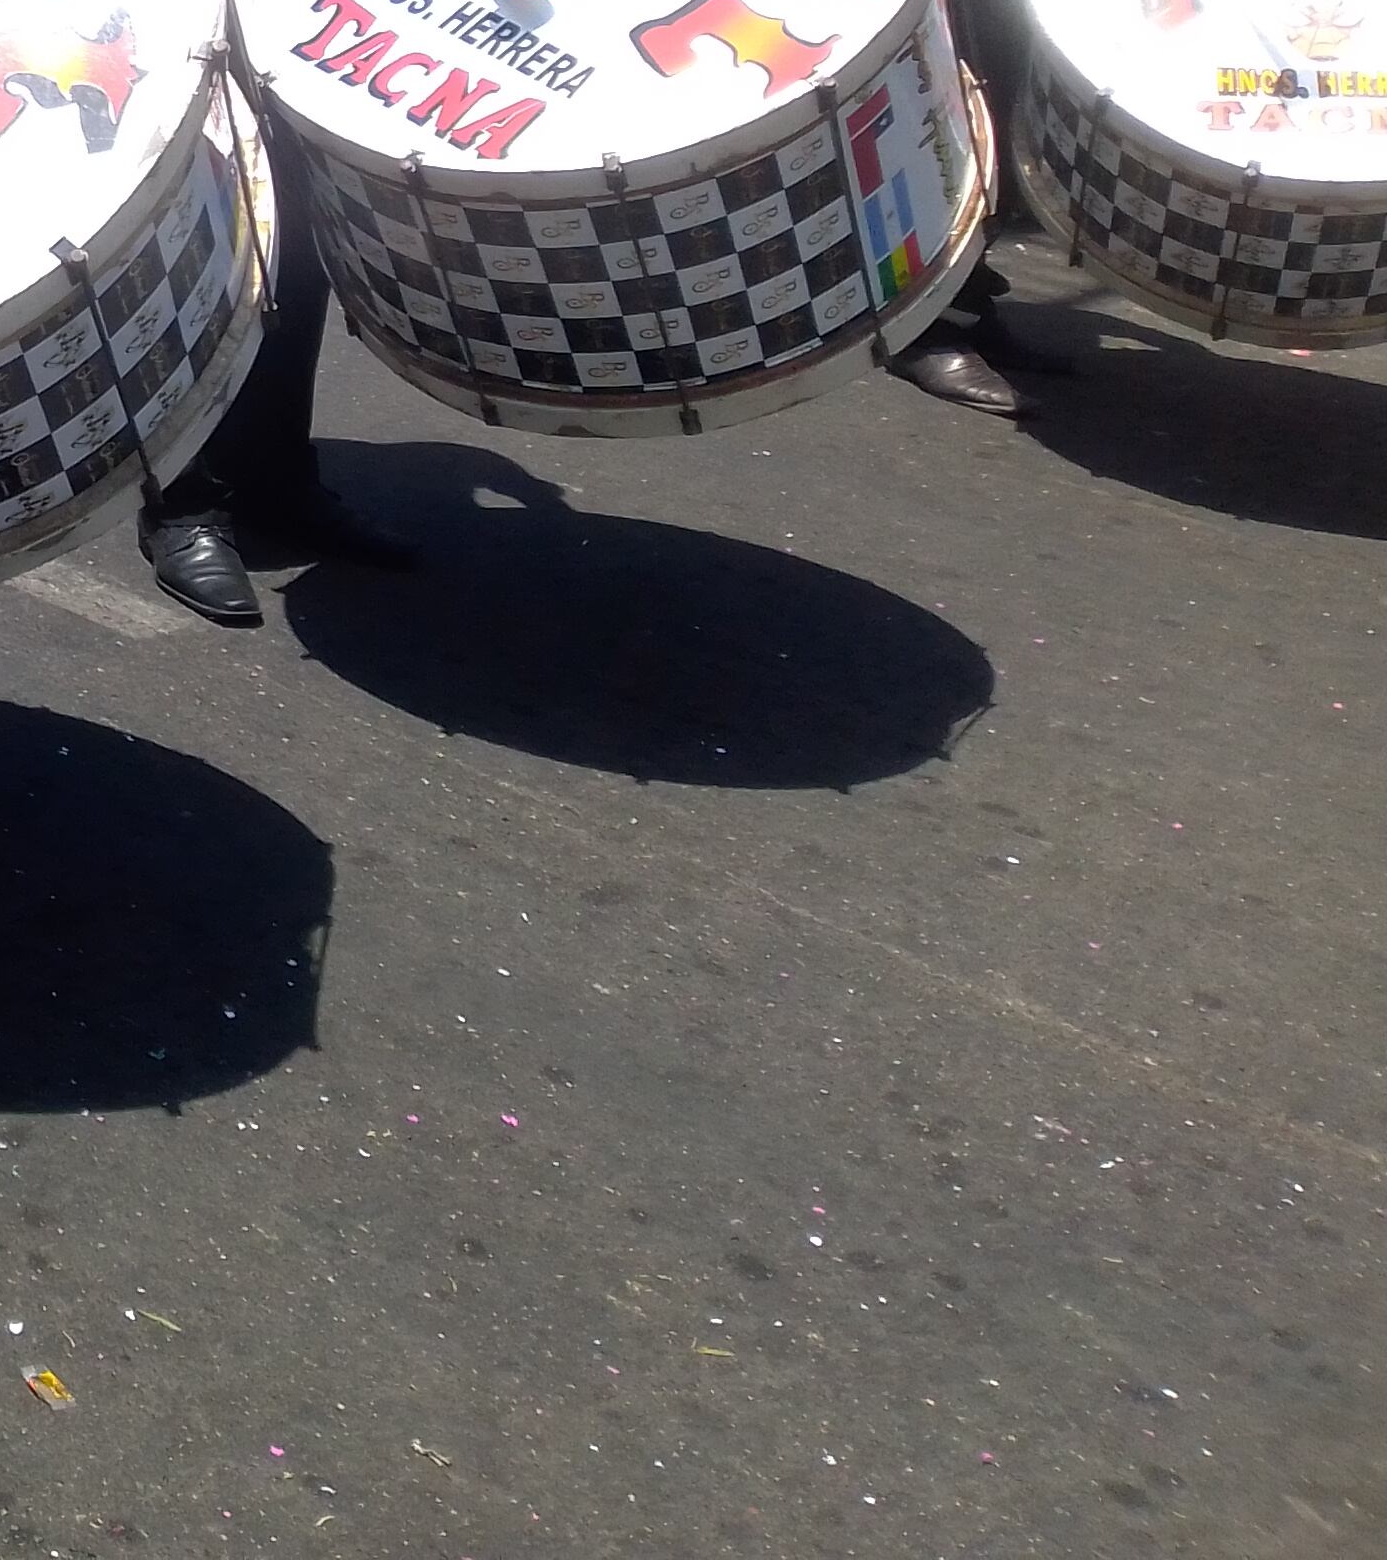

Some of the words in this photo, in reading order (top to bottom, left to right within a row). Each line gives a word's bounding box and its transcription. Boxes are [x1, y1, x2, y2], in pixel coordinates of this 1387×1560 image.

[446, 3, 598, 100] HERRERA
[1216, 67, 1309, 99] HNOS.
[1316, 70, 1387, 99] HERR
